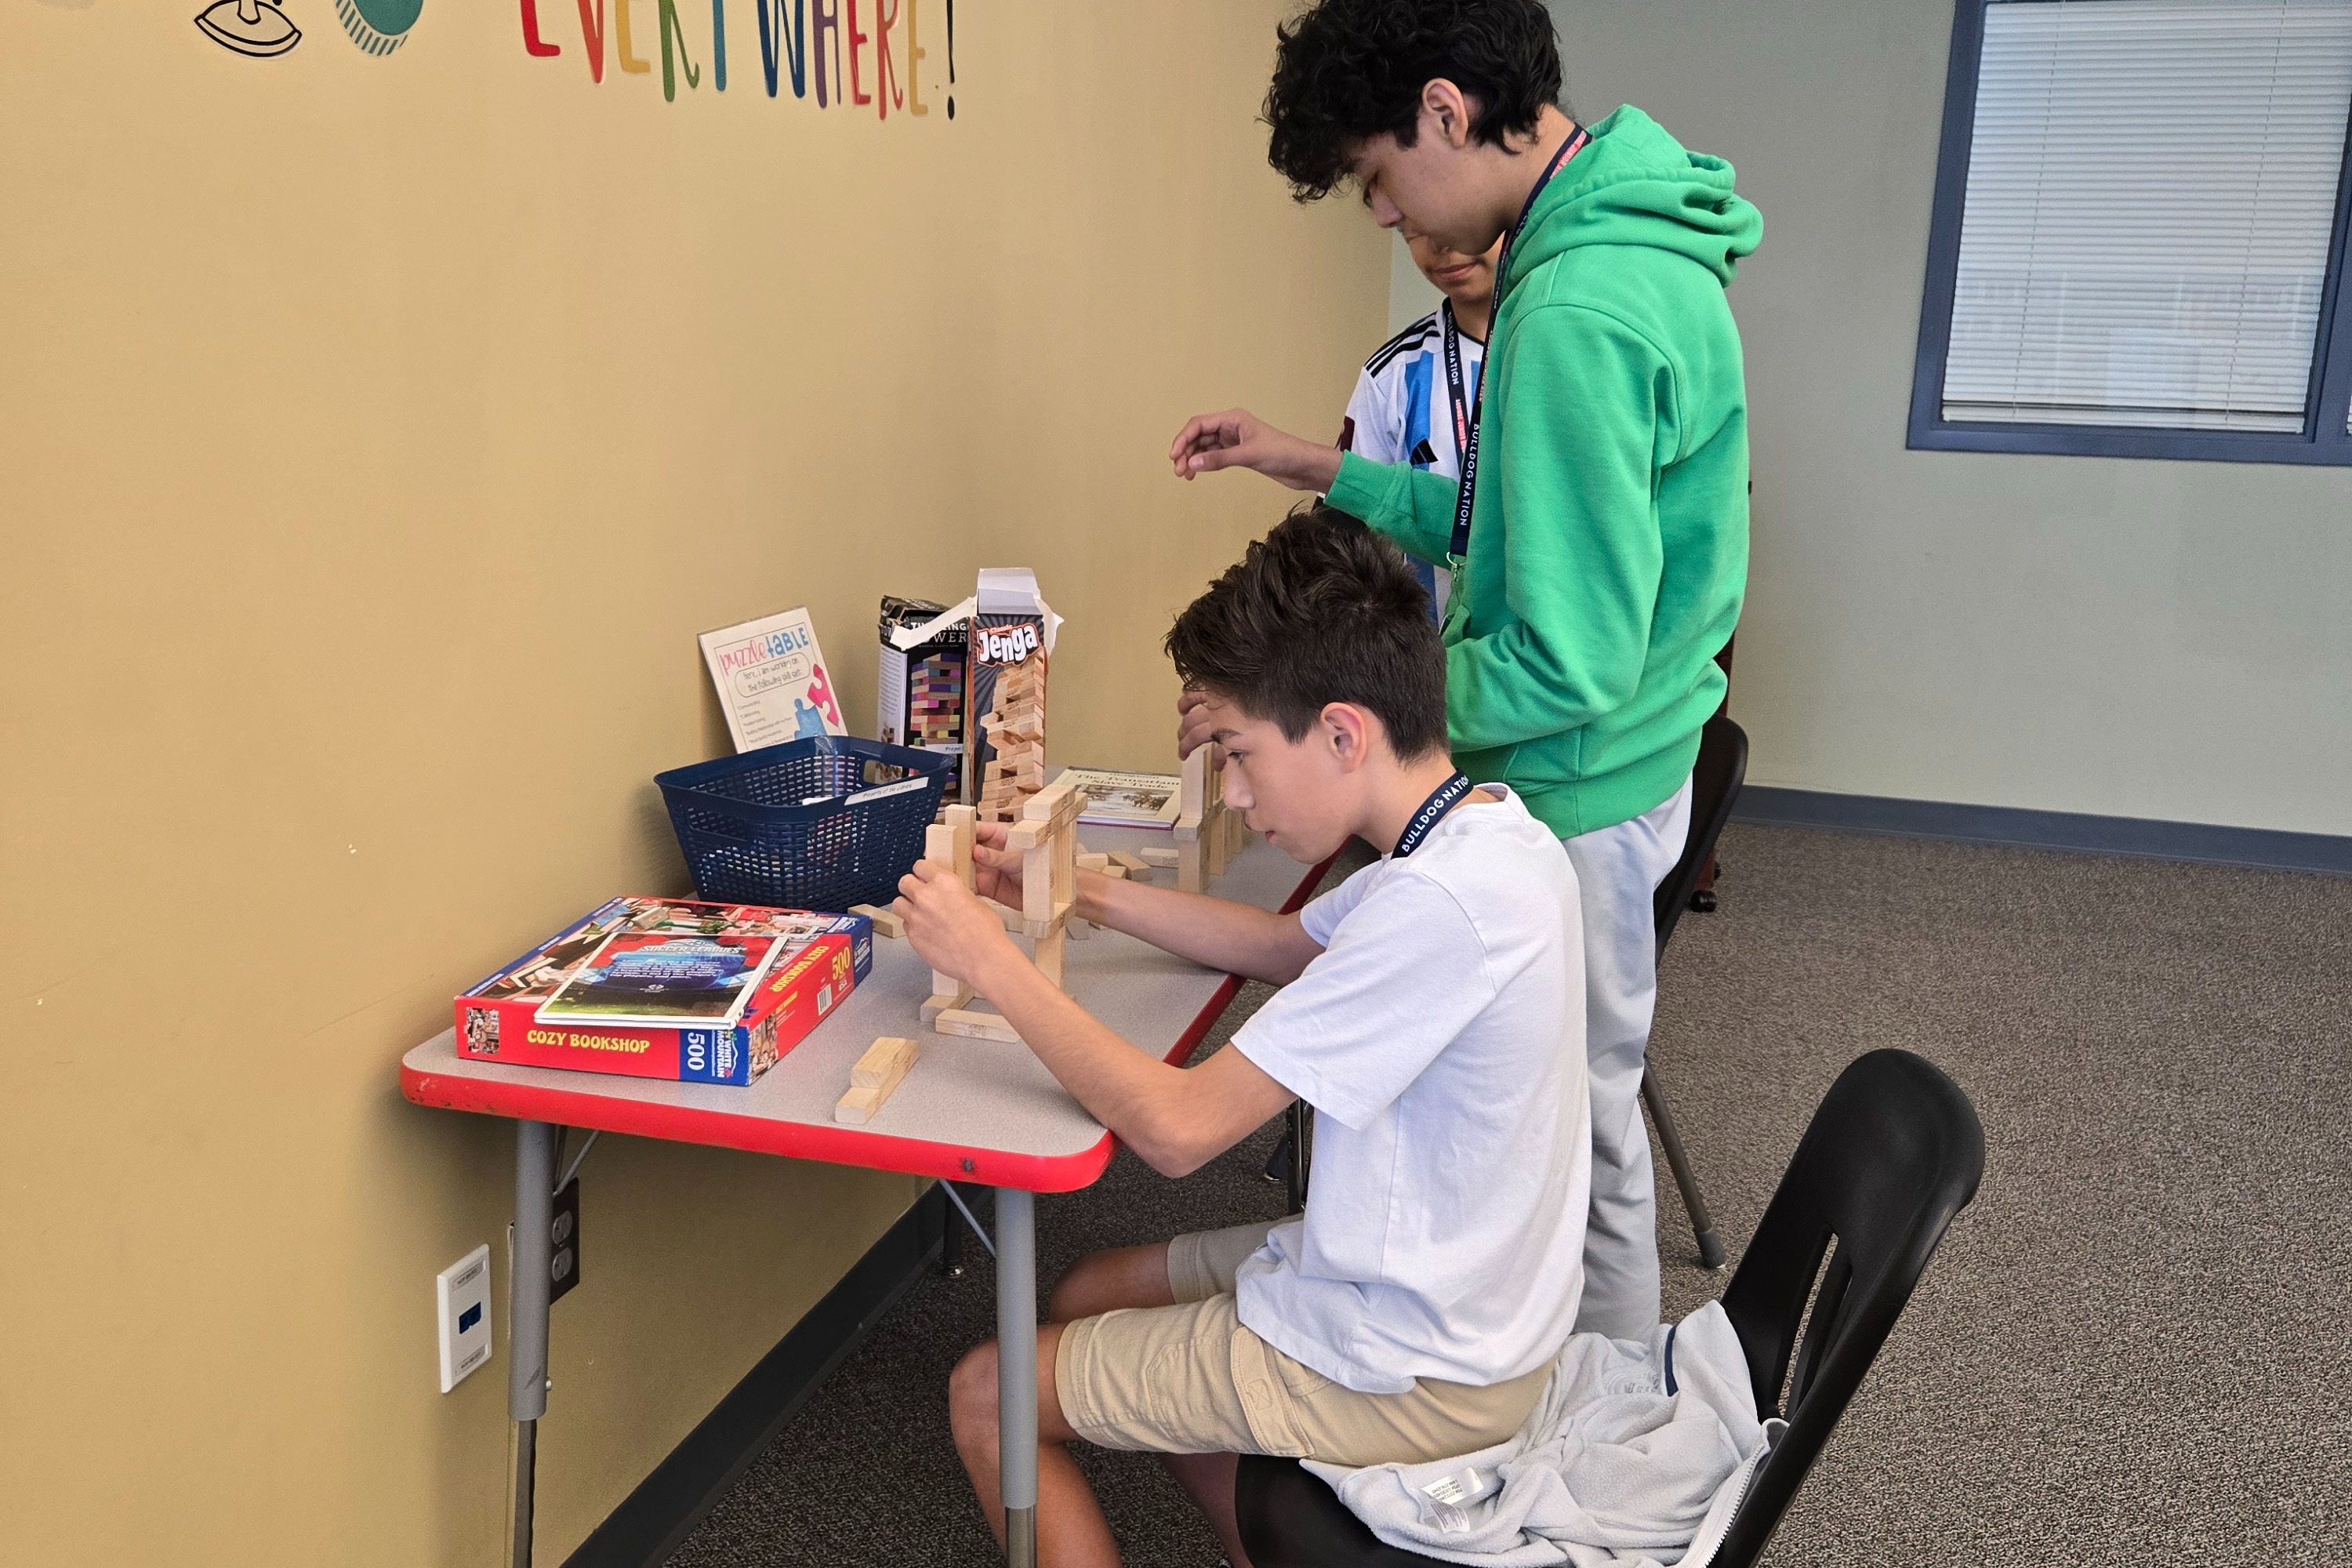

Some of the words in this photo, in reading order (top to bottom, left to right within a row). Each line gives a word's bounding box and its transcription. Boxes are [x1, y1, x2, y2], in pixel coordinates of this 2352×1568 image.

[1449, 350, 1460, 386] NATION
[1466, 423, 1480, 479] BULLDOG
[1460, 481, 1472, 527] NATION
[978, 625, 1038, 662] Jenga
[1401, 798, 1444, 853] BULLDOG
[690, 946, 740, 954] LEAGUES
[832, 946, 850, 980] 500
[527, 1029, 568, 1047] COZY
[569, 1033, 651, 1054] BOOKSHOP
[687, 1031, 706, 1071] 500
[717, 1030, 725, 1079] MOUNTAIN
[724, 1040, 732, 1069] WHITE
